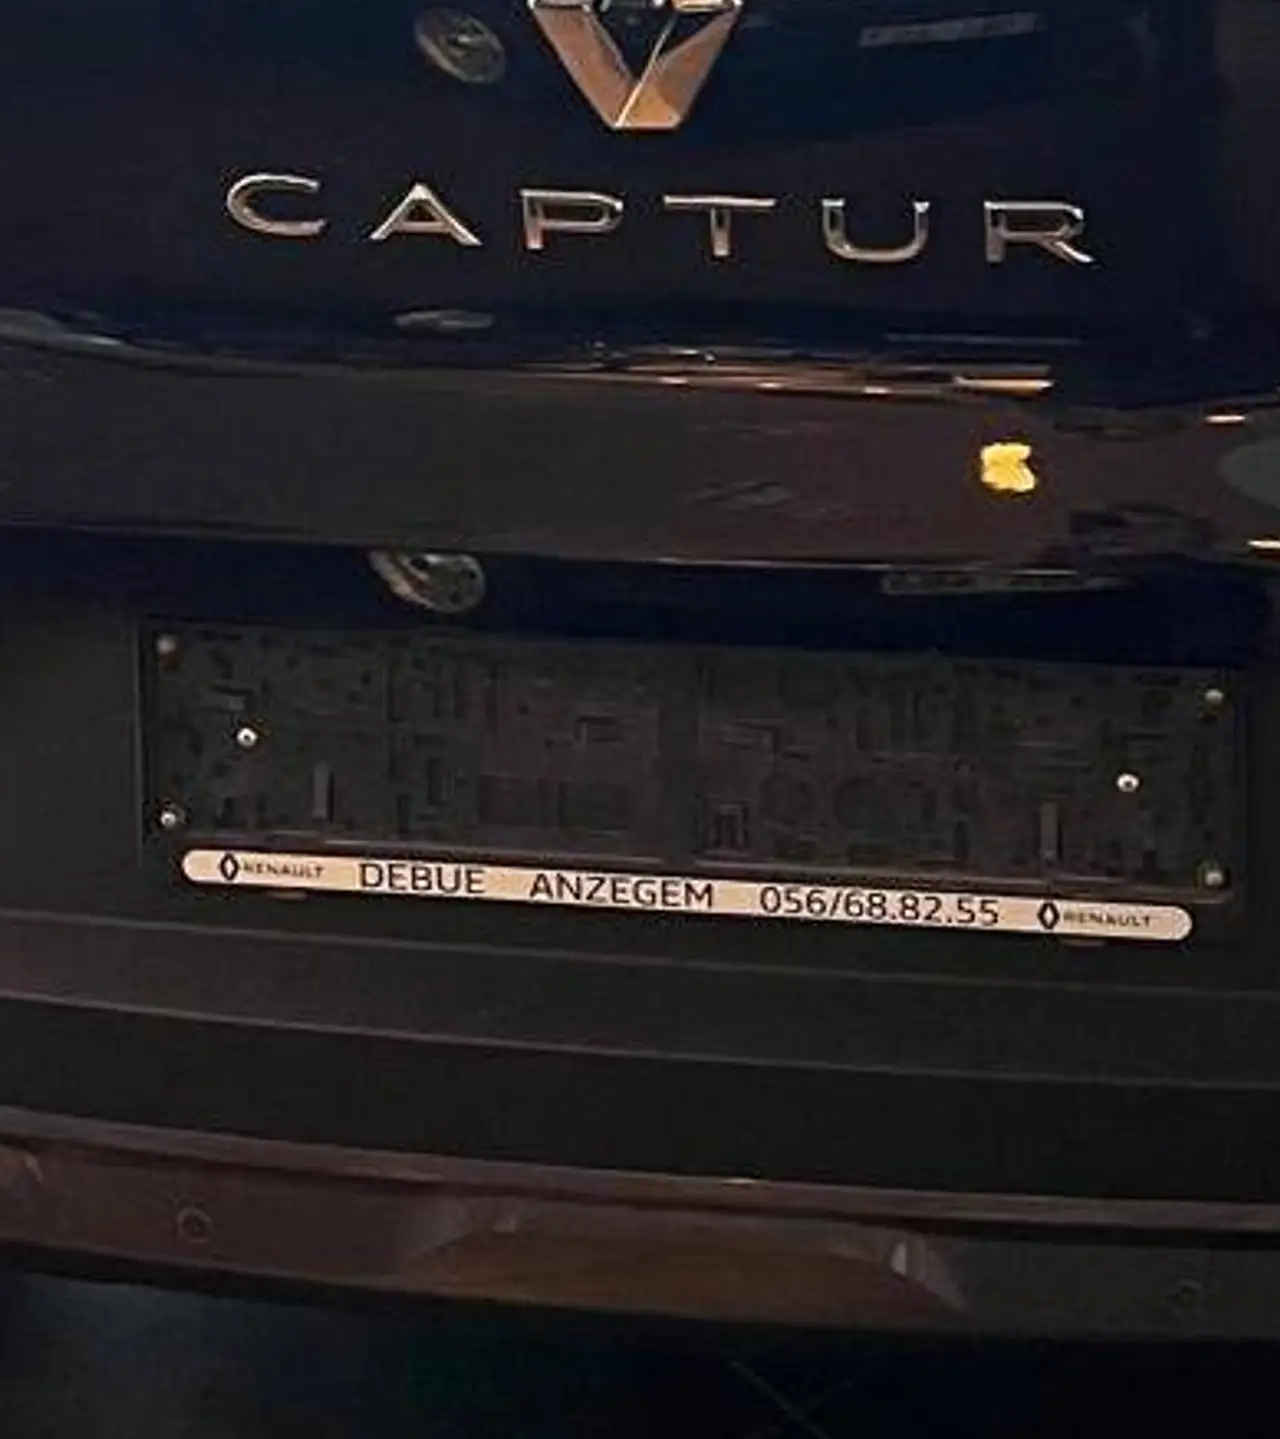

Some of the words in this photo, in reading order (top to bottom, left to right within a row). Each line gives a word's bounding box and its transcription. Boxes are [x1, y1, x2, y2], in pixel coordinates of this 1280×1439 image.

[226, 172, 1094, 264] CAPTUR
[243, 861, 324, 879] RENAULT
[358, 862, 488, 894] DEBUE
[529, 872, 713, 909] ANZEGEM
[759, 885, 1000, 928] 056/68.82.55
[1063, 910, 1152, 929] RENAULT
